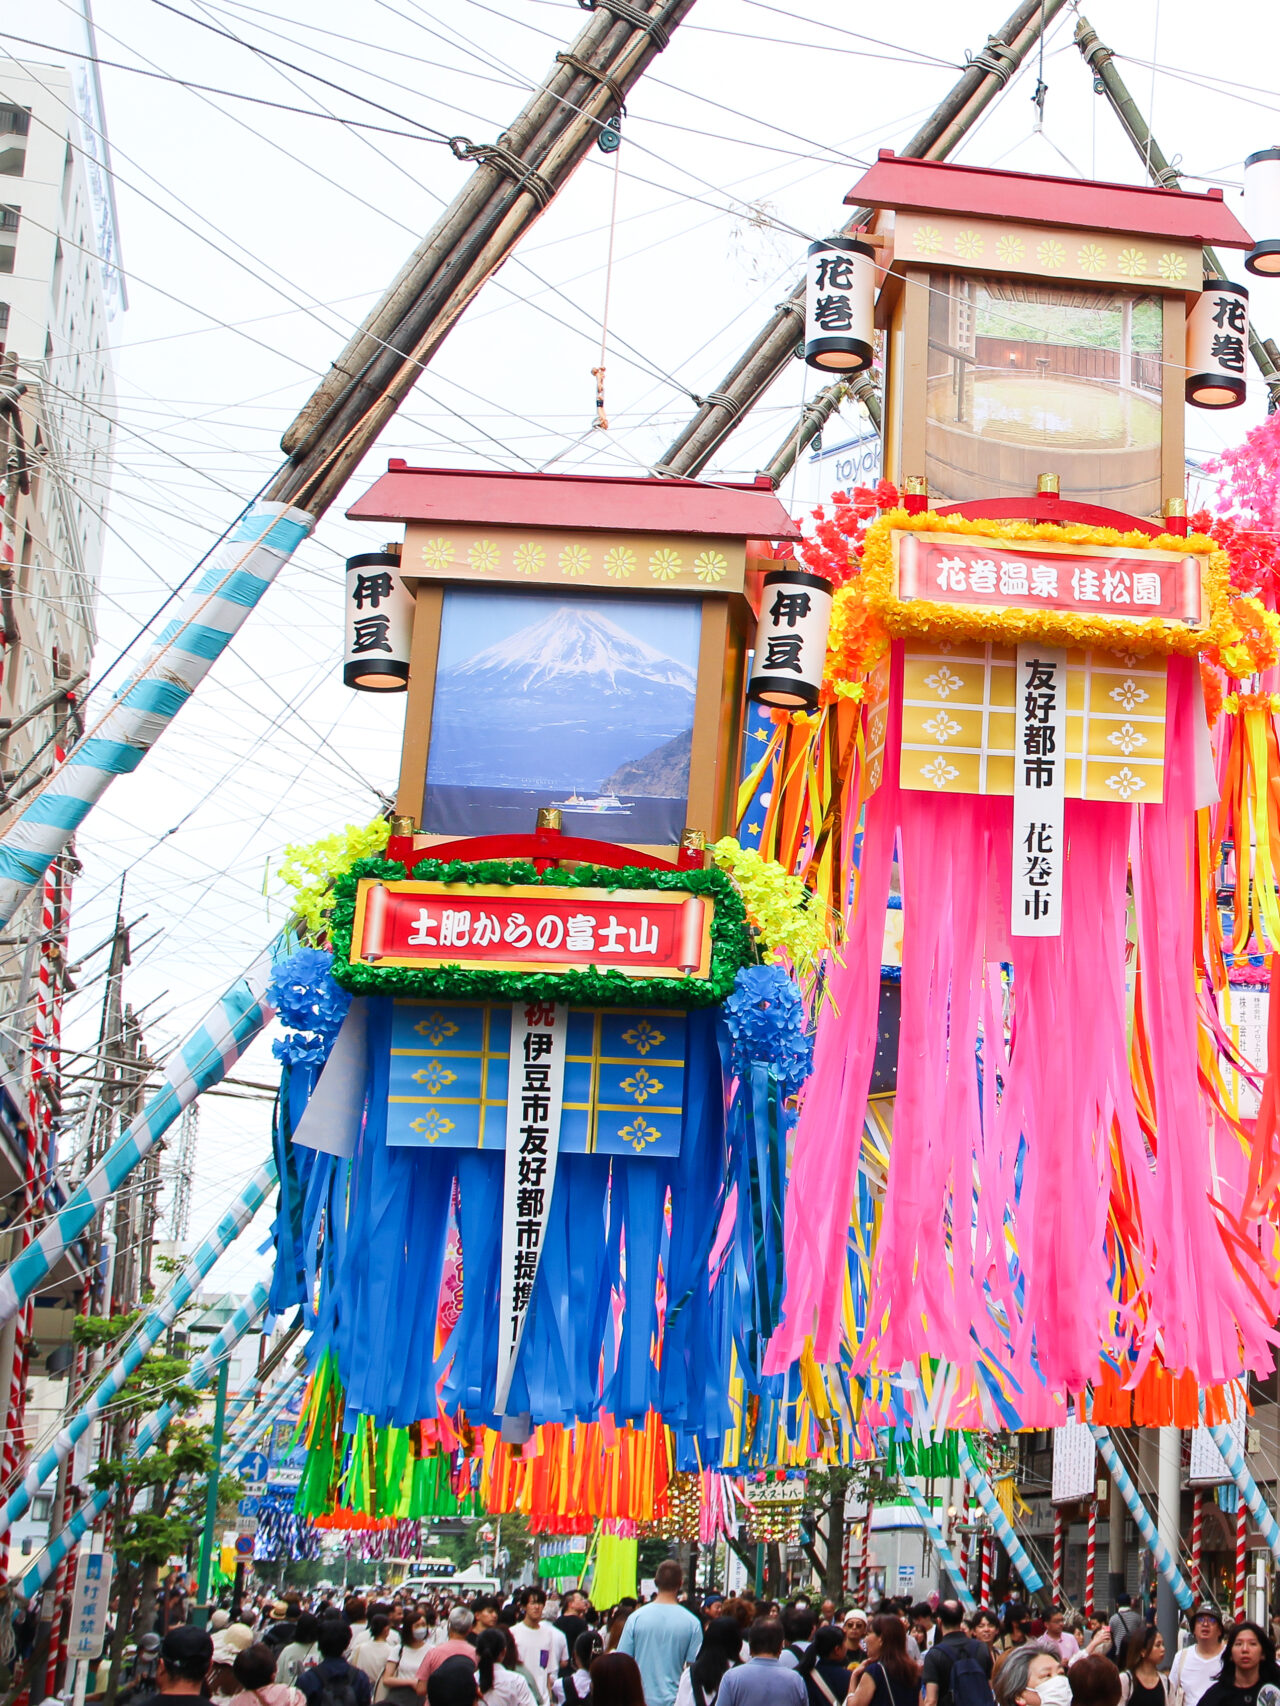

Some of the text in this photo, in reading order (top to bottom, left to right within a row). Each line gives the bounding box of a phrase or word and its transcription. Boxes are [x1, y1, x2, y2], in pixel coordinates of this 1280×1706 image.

[815, 255, 854, 332] 花巻
[1210, 296, 1247, 373] 花巻
[351, 572, 394, 654] 伊豆
[936, 556, 1161, 606] 花巻温泉 佳松園
[764, 590, 812, 673] 伊豆
[1022, 658, 1057, 921] 友好都市 花巻市
[407, 906, 660, 956] 土肥からの富士山
